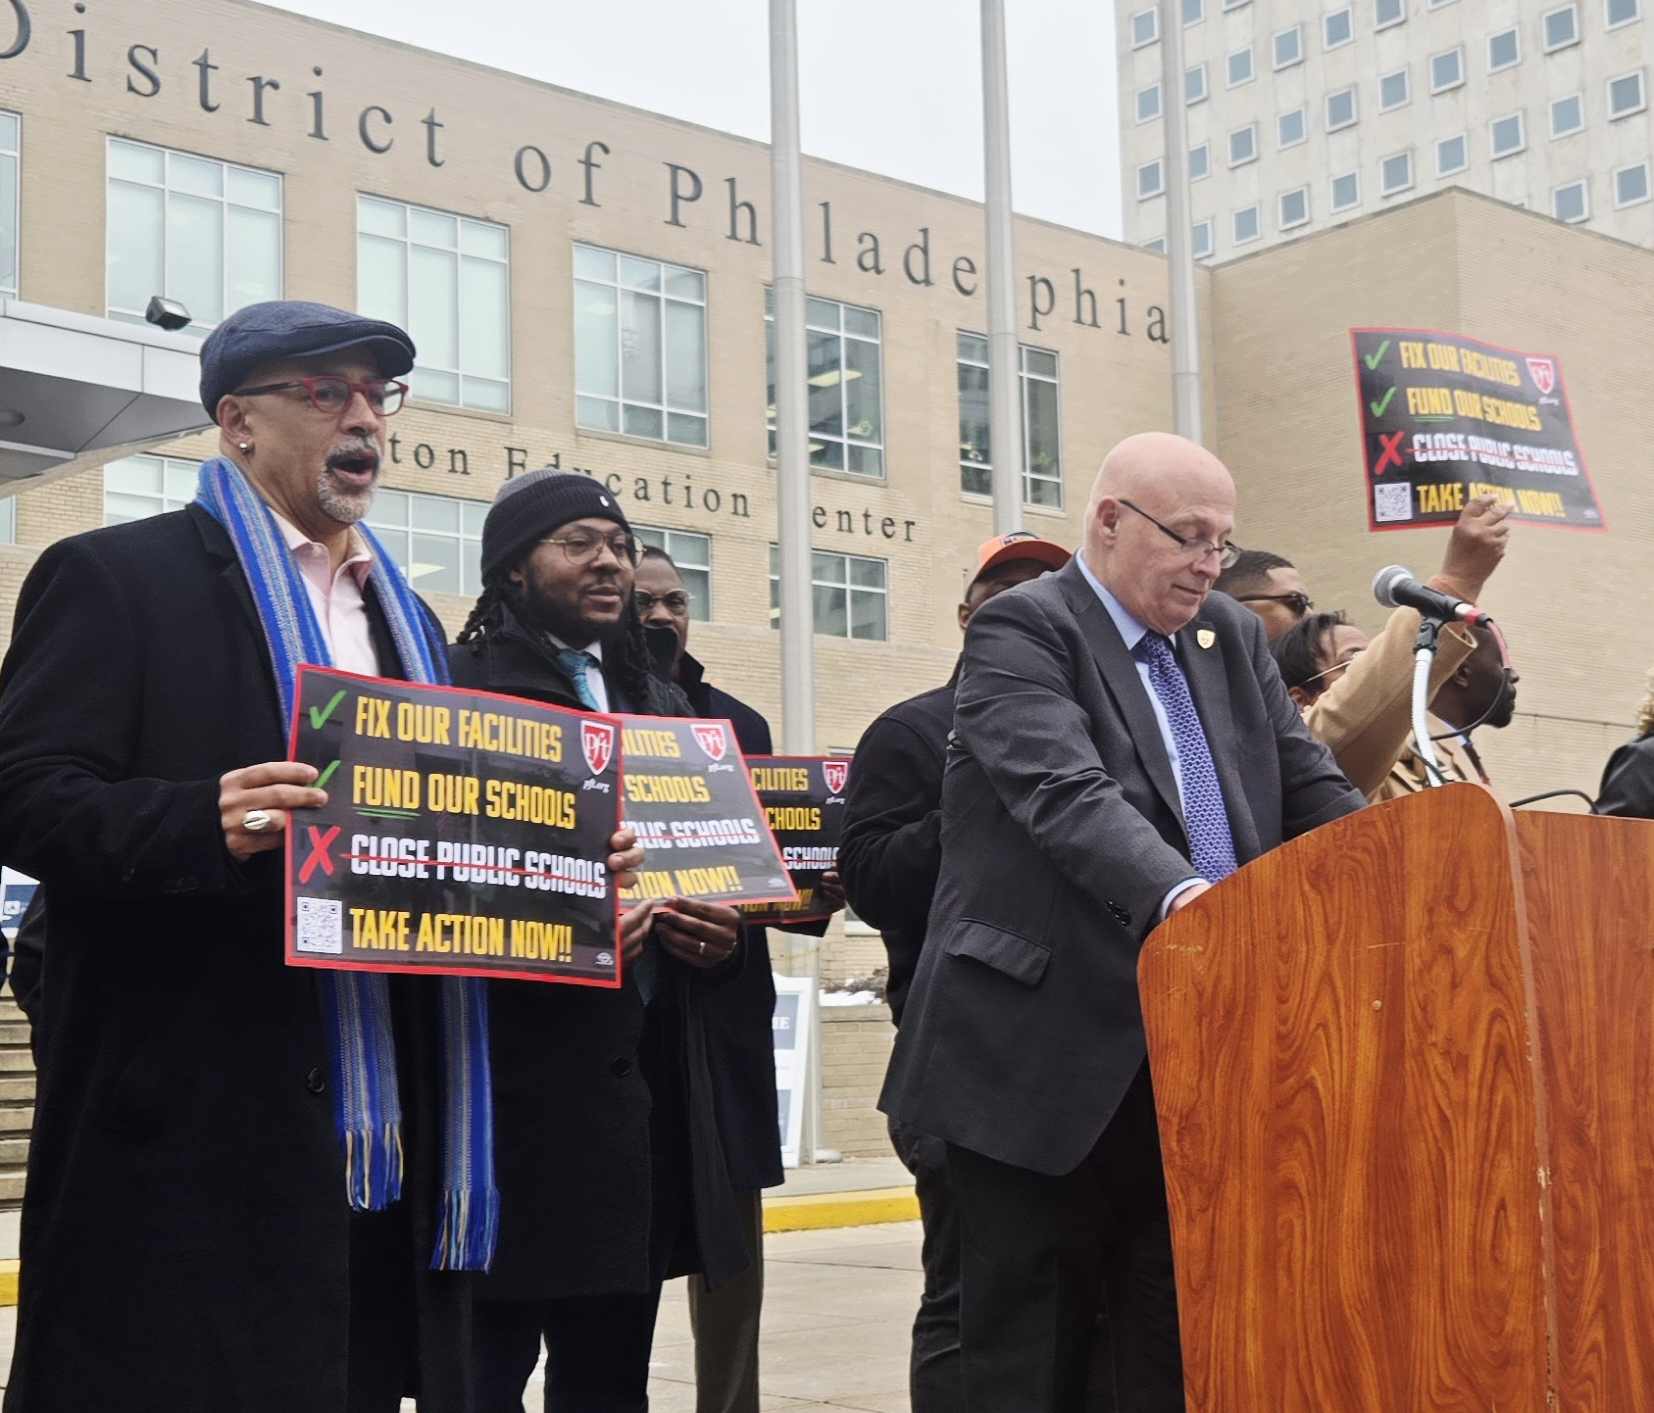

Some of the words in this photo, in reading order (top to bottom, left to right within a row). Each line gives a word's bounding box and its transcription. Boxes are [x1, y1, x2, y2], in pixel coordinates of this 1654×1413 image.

[514, 140, 610, 207] of
[662, 161, 1170, 345] Phladephia
[1399, 341, 1427, 369] FIX
[1426, 342, 1460, 373] OUR
[1460, 348, 1521, 388] FACILITIES
[1406, 387, 1454, 415] FUND
[1453, 389, 1484, 420] OUR
[1482, 395, 1543, 432] SCHOOLS
[1412, 433, 1469, 463] CLOSE
[1467, 435, 1516, 470] PUBLIC
[1513, 444, 1579, 476] SCHOOLS
[503, 445, 751, 518] Ecation
[811, 504, 918, 543] enter
[1416, 482, 1465, 513] TAKE
[355, 695, 393, 740] FIX
[397, 702, 451, 747] OUR
[458, 708, 564, 764] FACILITIES
[352, 765, 421, 810] FUND
[427, 773, 480, 816] OUR
[486, 779, 577, 830] SCHOOLS
[623, 774, 711, 804] SCHOOLS
[750, 767, 809, 792] CILITIES
[669, 818, 761, 849] SCHOOLS
[764, 806, 822, 831] CHOOLS
[351, 833, 430, 880] CLOSE
[436, 841, 521, 888] PUBLIC
[524, 850, 607, 900] SCHOOLS
[674, 865, 744, 896] NOW!!
[349, 907, 411, 951] TAKE
[415, 912, 504, 956] ACTION
[510, 919, 573, 964] NOW!!
